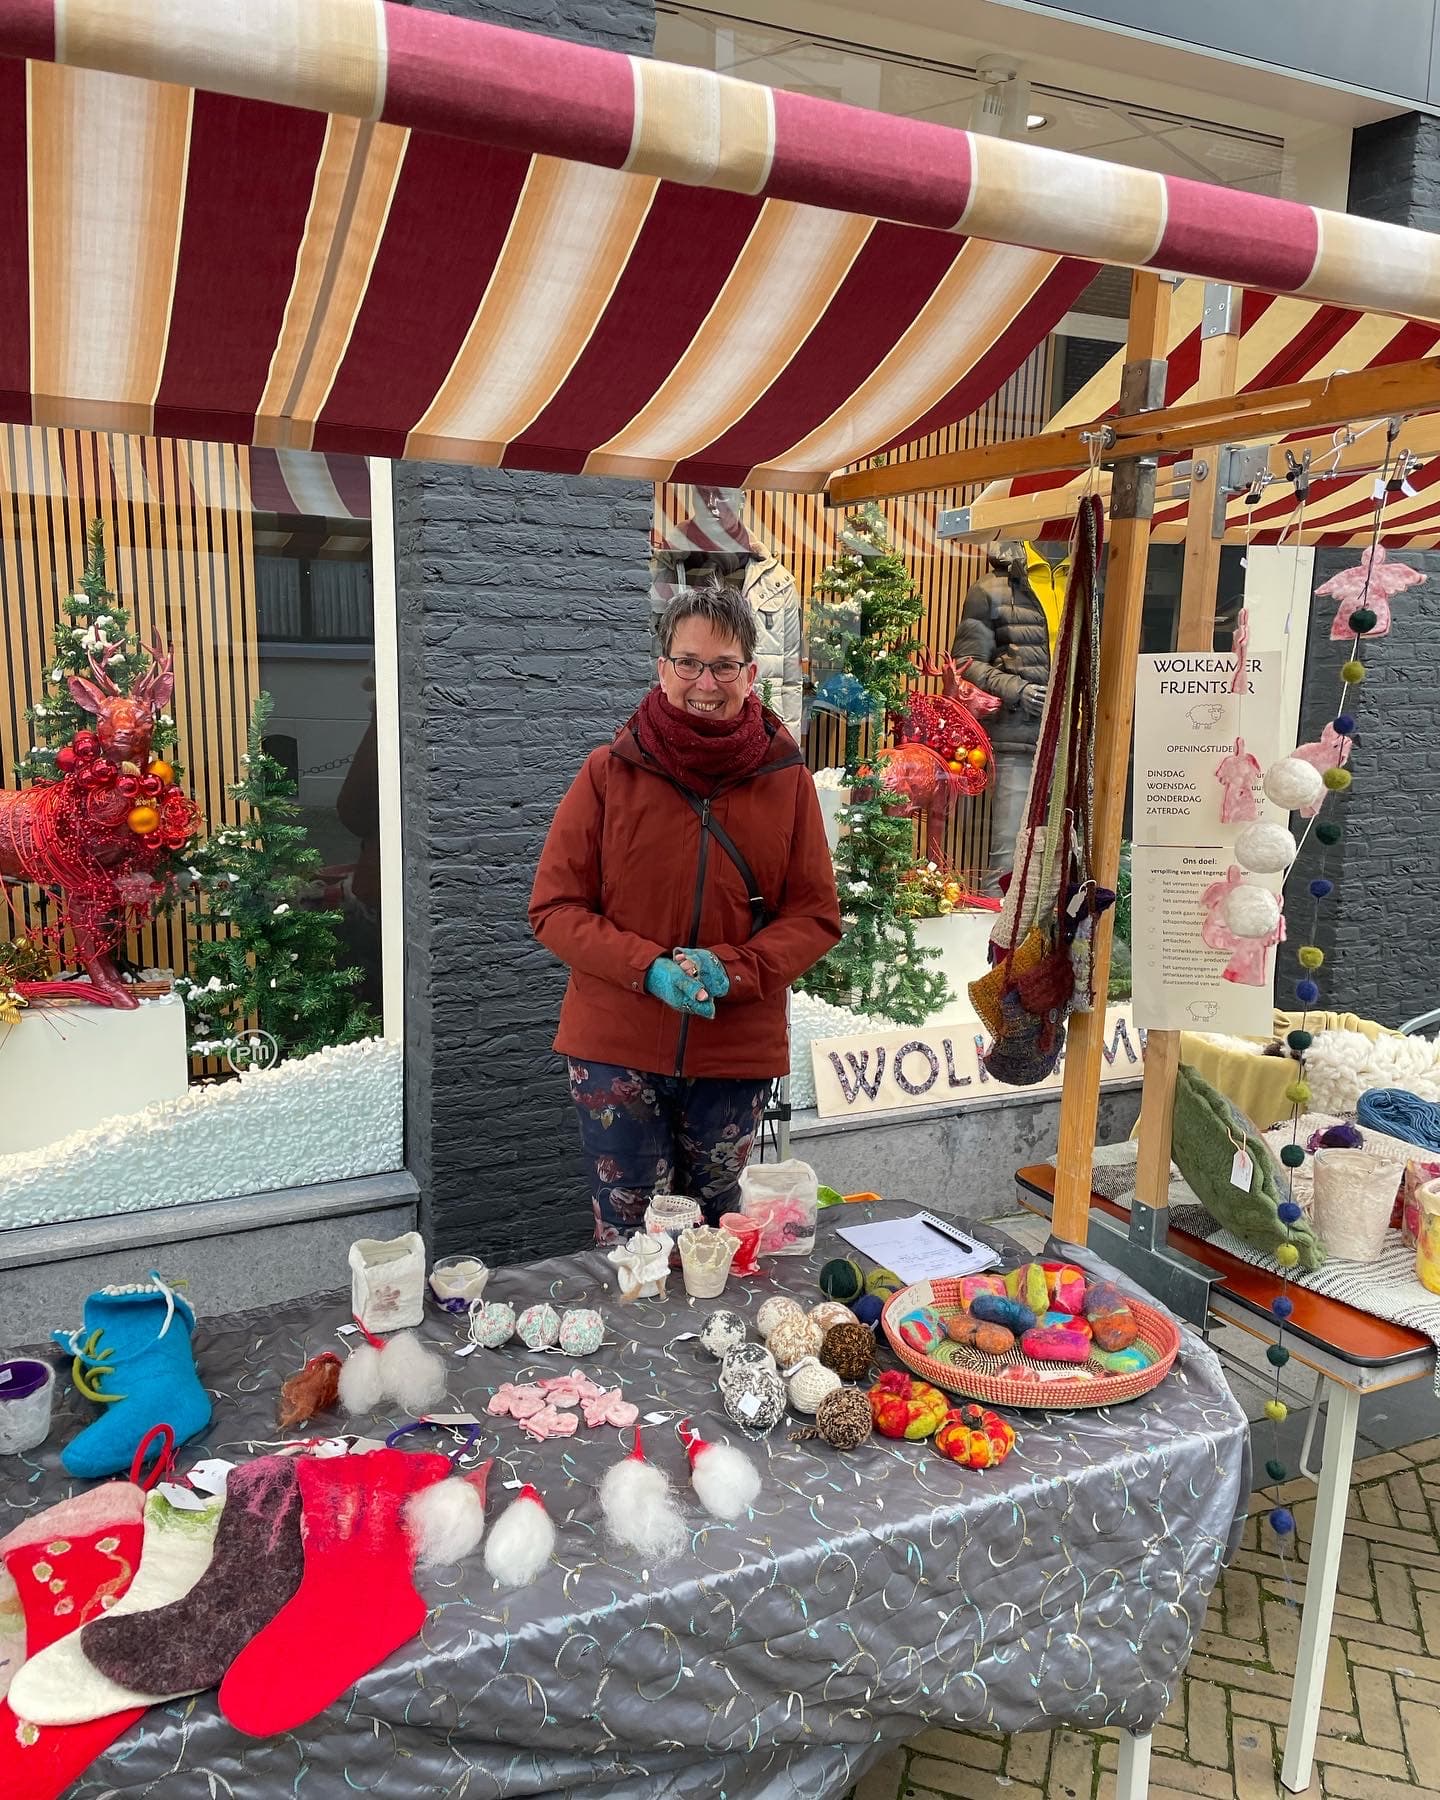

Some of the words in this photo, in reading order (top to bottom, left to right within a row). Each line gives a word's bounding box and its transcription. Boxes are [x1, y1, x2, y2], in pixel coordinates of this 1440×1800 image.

[1166, 745, 1233, 753] OPENINGSTIJDE
[1147, 770, 1185, 778] DINSDAG
[1147, 782, 1197, 790] WOENSDAG
[1146, 794, 1202, 803] DONDERDAG
[1146, 807, 1191, 815] ZATERDAG
[1182, 857, 1197, 865] Ons
[1198, 857, 1217, 865] doel:
